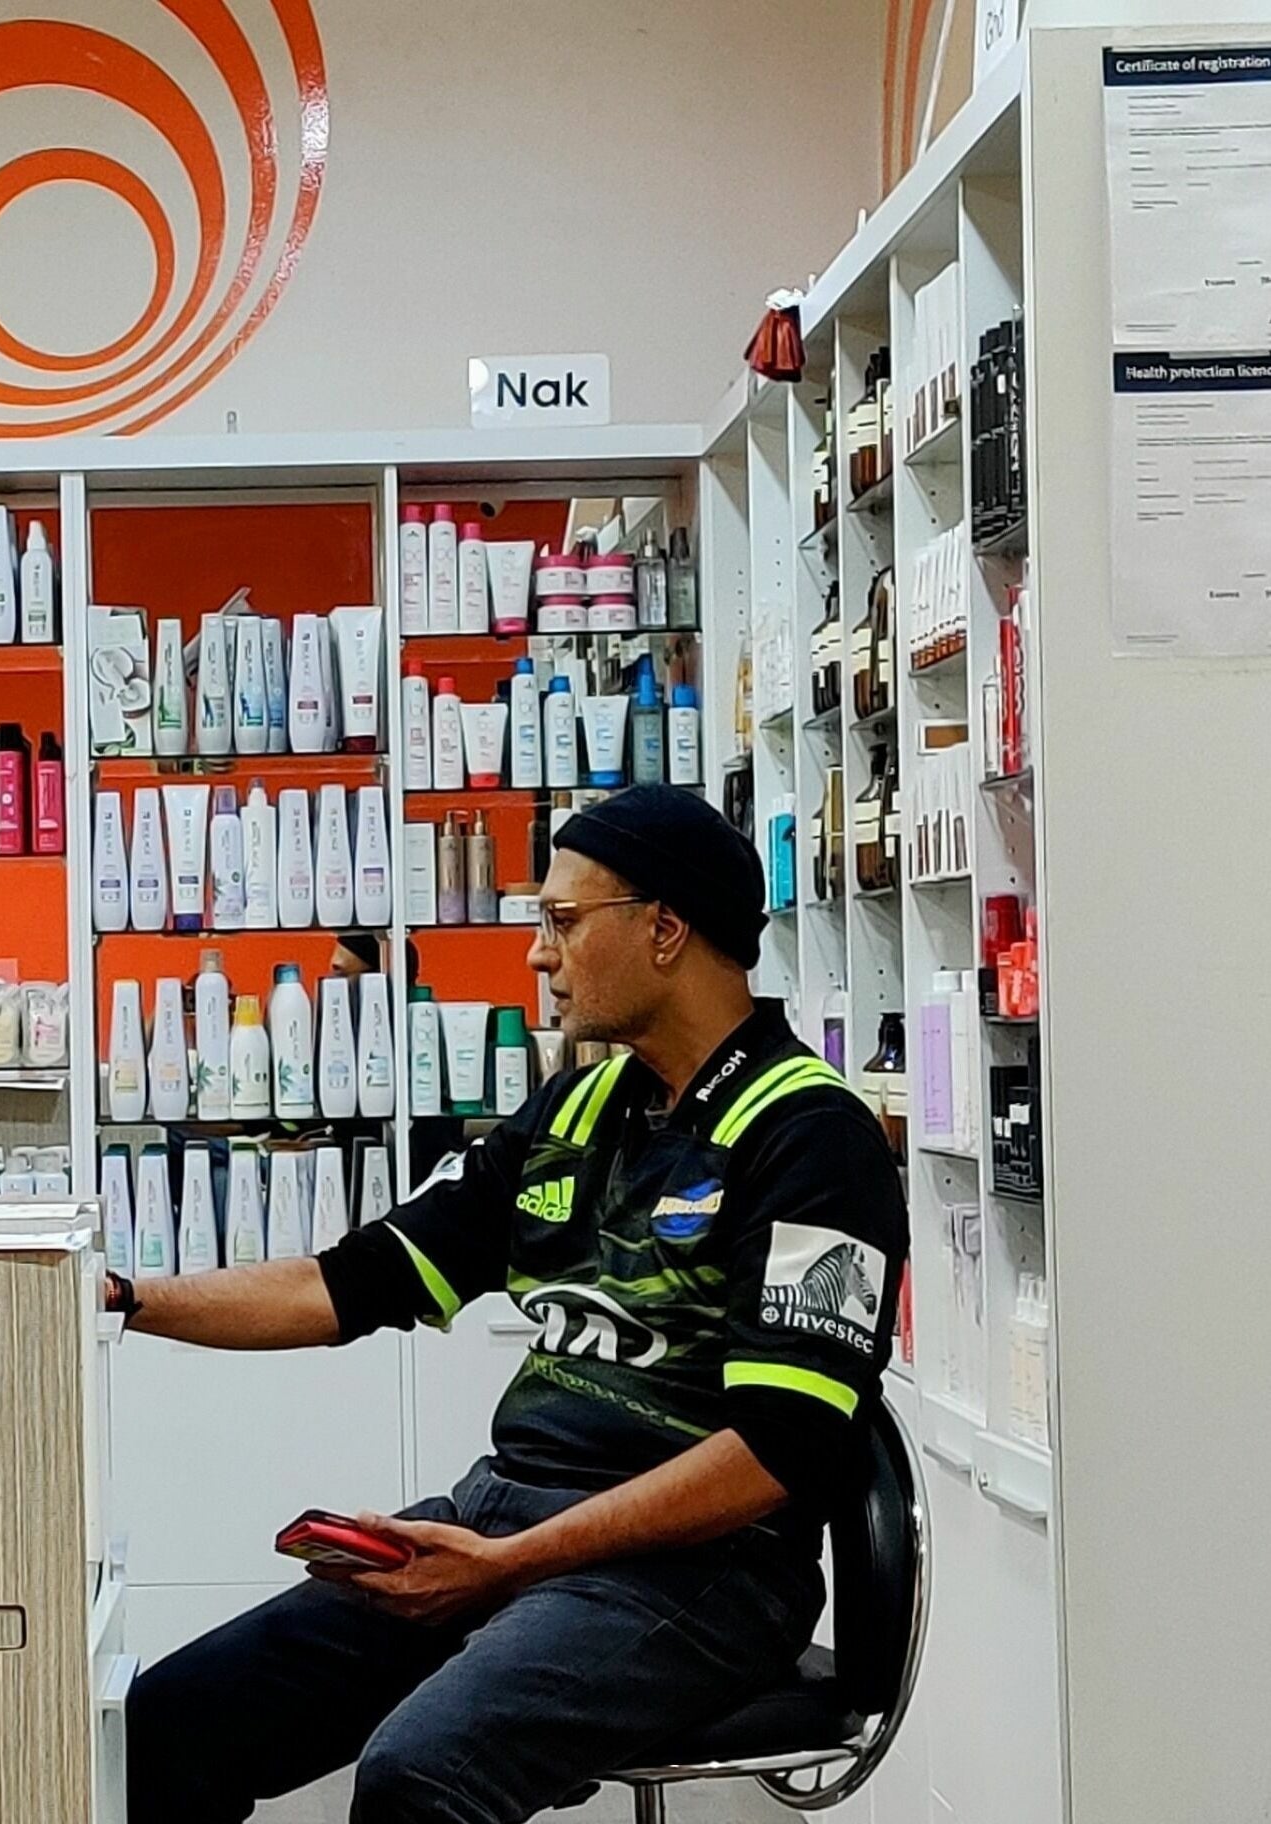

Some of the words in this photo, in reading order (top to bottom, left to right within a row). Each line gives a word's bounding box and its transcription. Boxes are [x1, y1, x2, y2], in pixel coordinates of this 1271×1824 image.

[1115, 59, 1180, 74] Certificate
[1182, 57, 1197, 71] of
[1198, 56, 1270, 74] registration
[497, 371, 589, 408] Nak
[1126, 365, 1168, 379] Health
[1169, 365, 1235, 383] protection
[695, 1049, 748, 1103] RICOH
[783, 1305, 875, 1354] Investec
